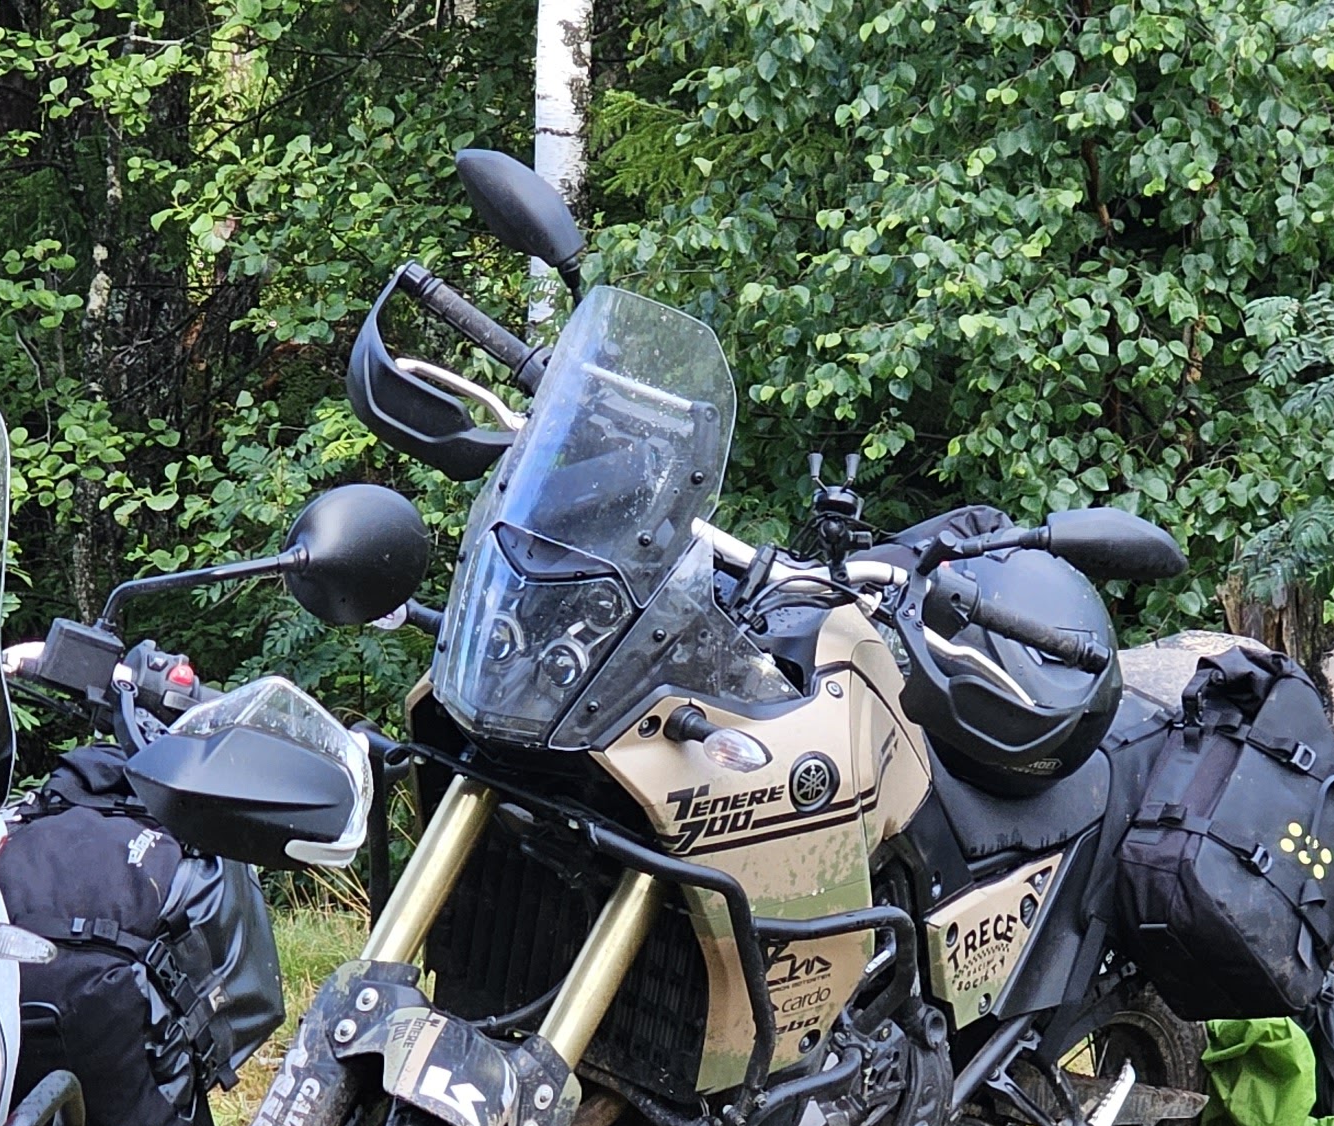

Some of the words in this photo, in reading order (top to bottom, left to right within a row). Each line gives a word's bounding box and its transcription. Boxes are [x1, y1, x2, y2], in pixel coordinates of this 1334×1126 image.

[673, 809, 755, 852] 700
[947, 914, 1018, 972] TRECE
[781, 986, 831, 1013] cardo
